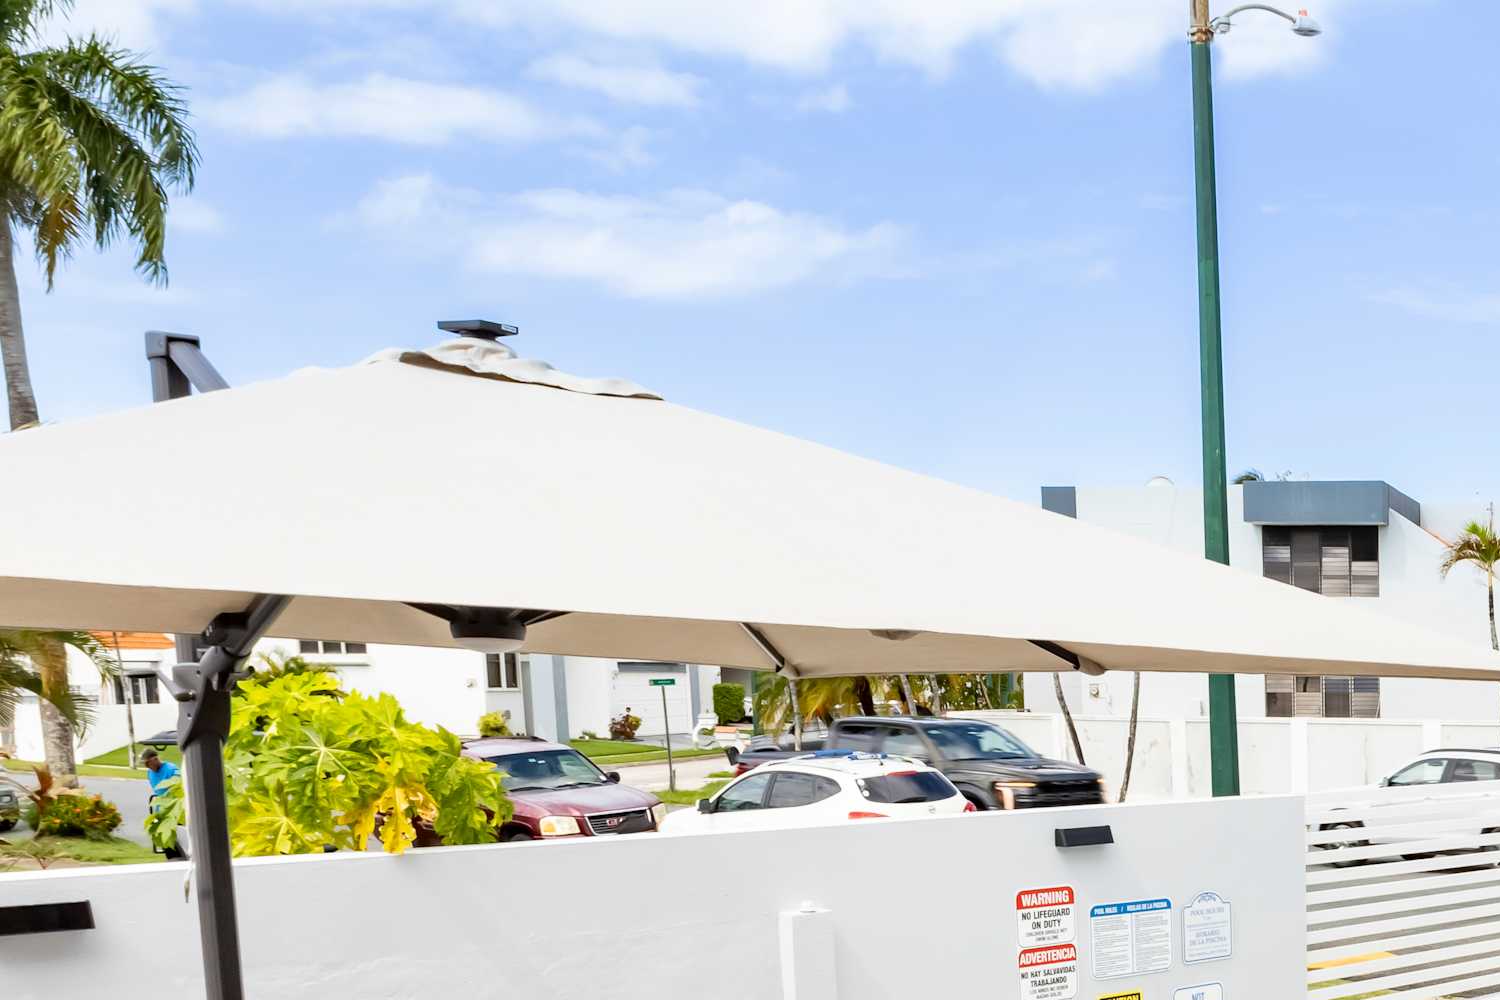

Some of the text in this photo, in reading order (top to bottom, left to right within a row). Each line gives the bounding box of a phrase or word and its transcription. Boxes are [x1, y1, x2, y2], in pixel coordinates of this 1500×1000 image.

[1020, 890, 1069, 907] WARNING
[1021, 907, 1071, 920] NO LIFEGUARD
[1031, 919, 1061, 930] ON DUTY
[1020, 947, 1076, 965] ADVERTENCIA
[1030, 970, 1041, 978] HAY
[1043, 965, 1076, 976] SALVAVIDAS
[1030, 976, 1067, 987] TRABAJANDO
